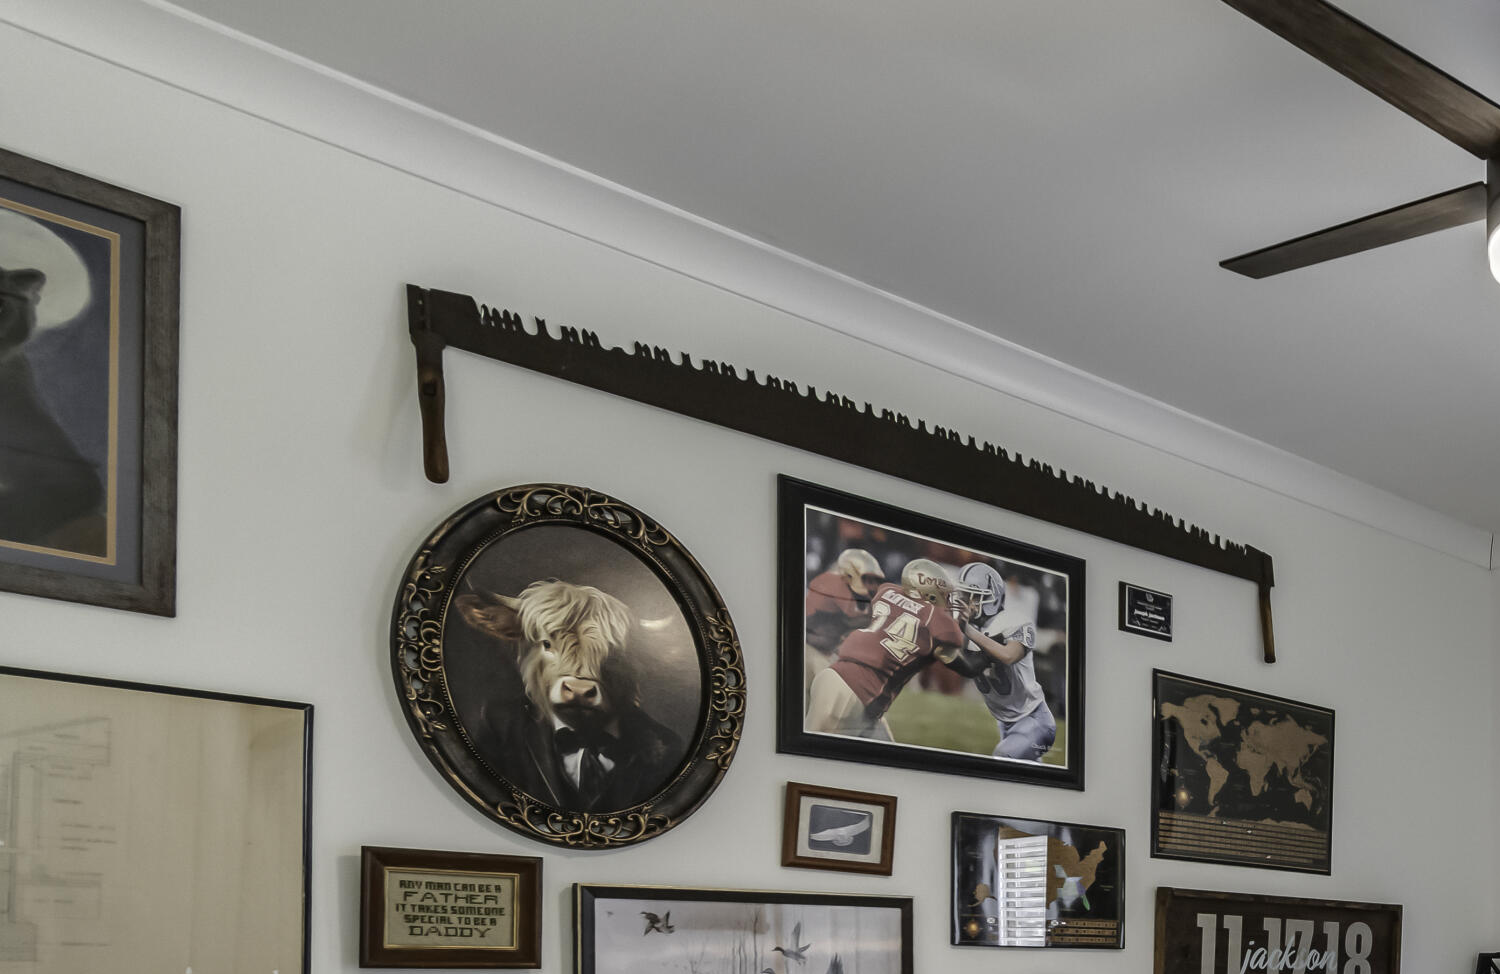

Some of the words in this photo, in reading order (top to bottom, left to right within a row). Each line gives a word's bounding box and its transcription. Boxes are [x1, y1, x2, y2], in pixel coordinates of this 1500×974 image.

[399, 880, 422, 889] ANY
[425, 881, 451, 891] MAN
[454, 883, 475, 892] CAN
[478, 884, 491, 893] BE
[494, 884, 501, 893] A
[403, 891, 498, 905] FATHER
[396, 903, 406, 912] IT
[410, 904, 448, 914] TAKES
[450, 905, 505, 916] SOMEONE
[403, 914, 453, 925] SPECIAL
[457, 916, 471, 925] TO
[473, 917, 487, 926] BE
[489, 917, 497, 926] A
[408, 925, 491, 938] DADDY
